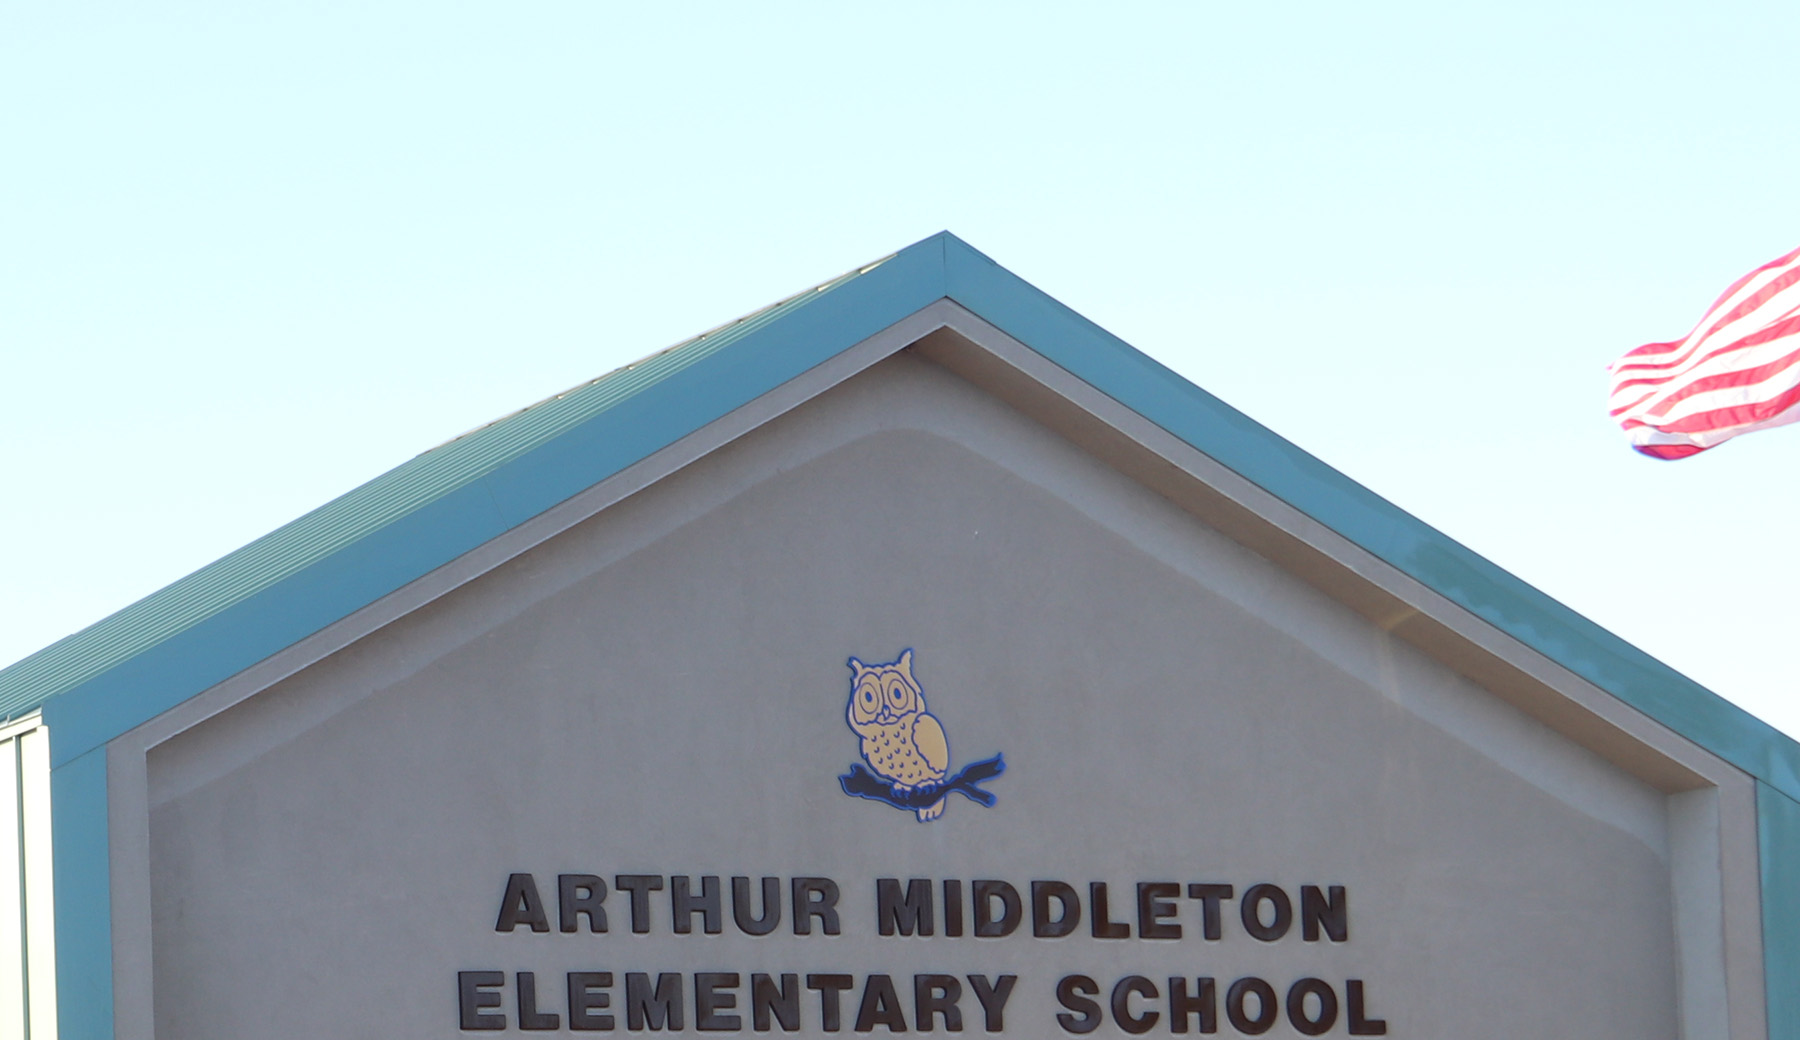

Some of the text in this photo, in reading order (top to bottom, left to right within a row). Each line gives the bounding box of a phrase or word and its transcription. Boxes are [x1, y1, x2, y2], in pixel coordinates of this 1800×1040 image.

[495, 872, 1348, 943] ARTHUR MIDDLETON
[457, 970, 1388, 1036] ELEMENTARY SCHOOL
